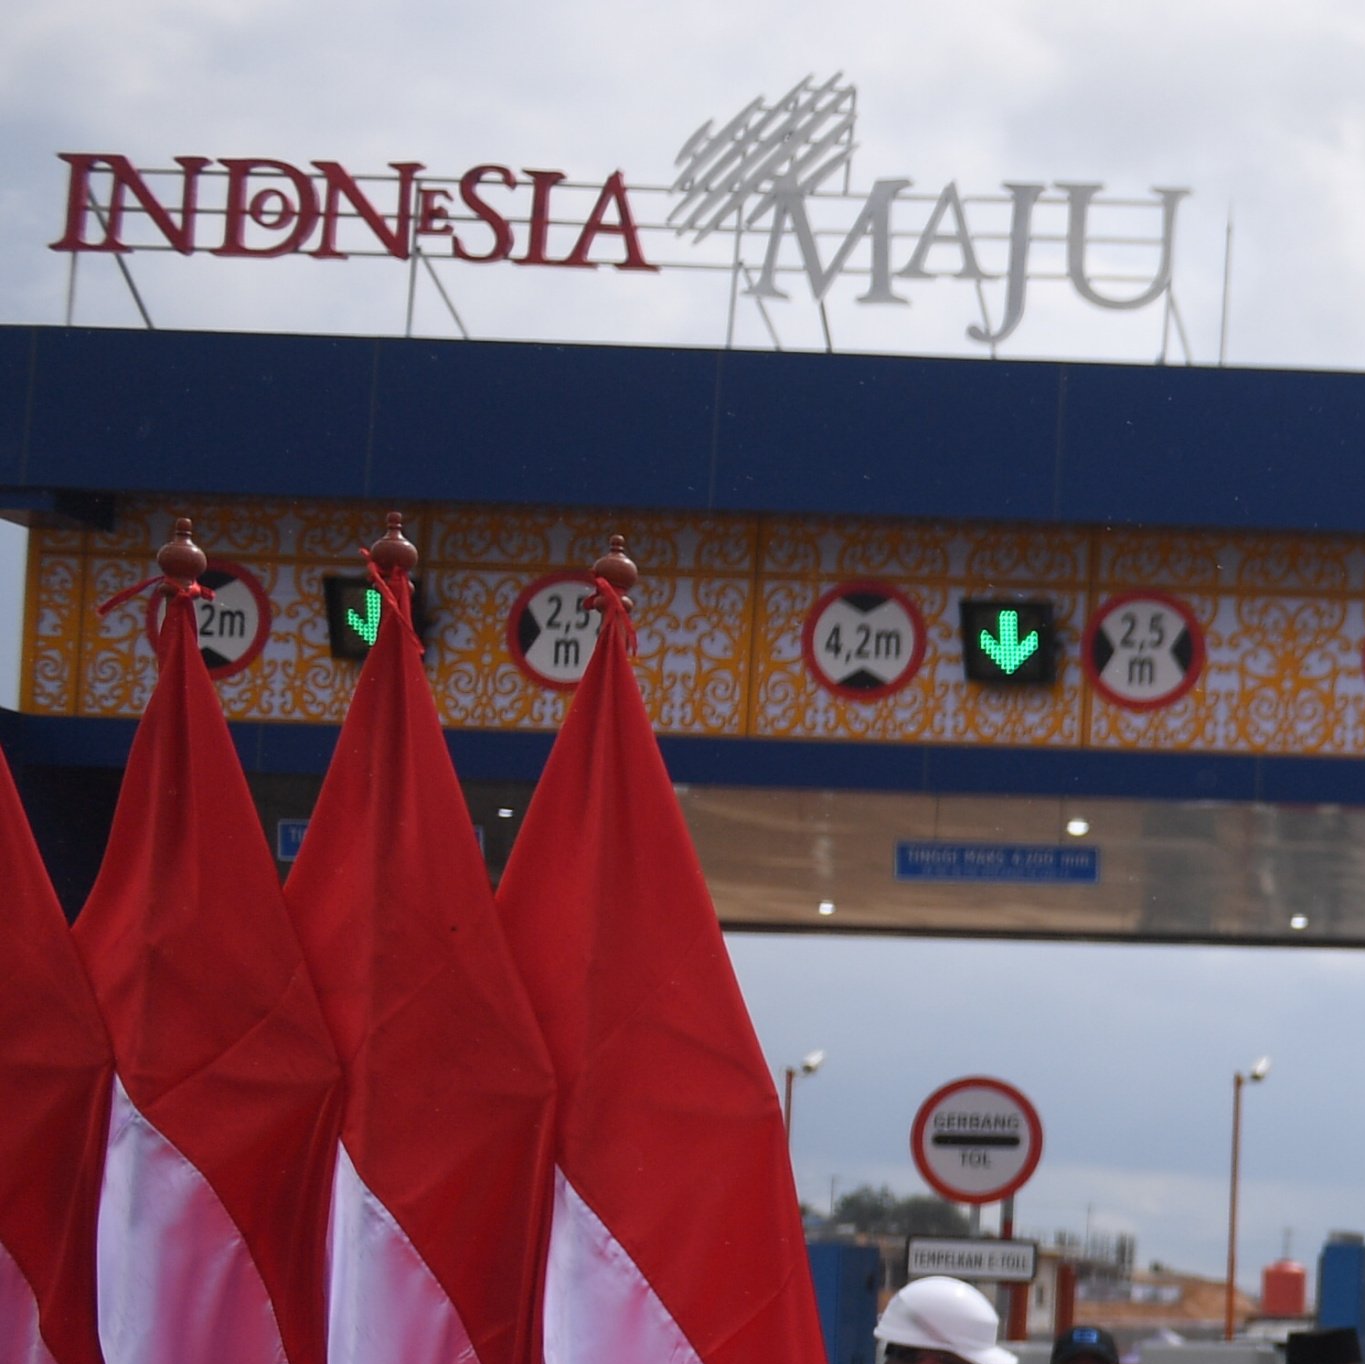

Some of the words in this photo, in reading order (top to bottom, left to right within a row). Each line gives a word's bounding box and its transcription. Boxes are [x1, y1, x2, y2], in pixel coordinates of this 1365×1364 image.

[49, 152, 661, 272] INDONESIA
[742, 176, 1192, 343] MAJU
[825, 622, 901, 665] 4,2m
[1120, 611, 1164, 652] 2,5
[1127, 656, 1154, 685] m
[934, 1111, 1020, 1130] GERBANG
[961, 1151, 991, 1169] TOL
[913, 1252, 983, 1269] TEMPELKAN
